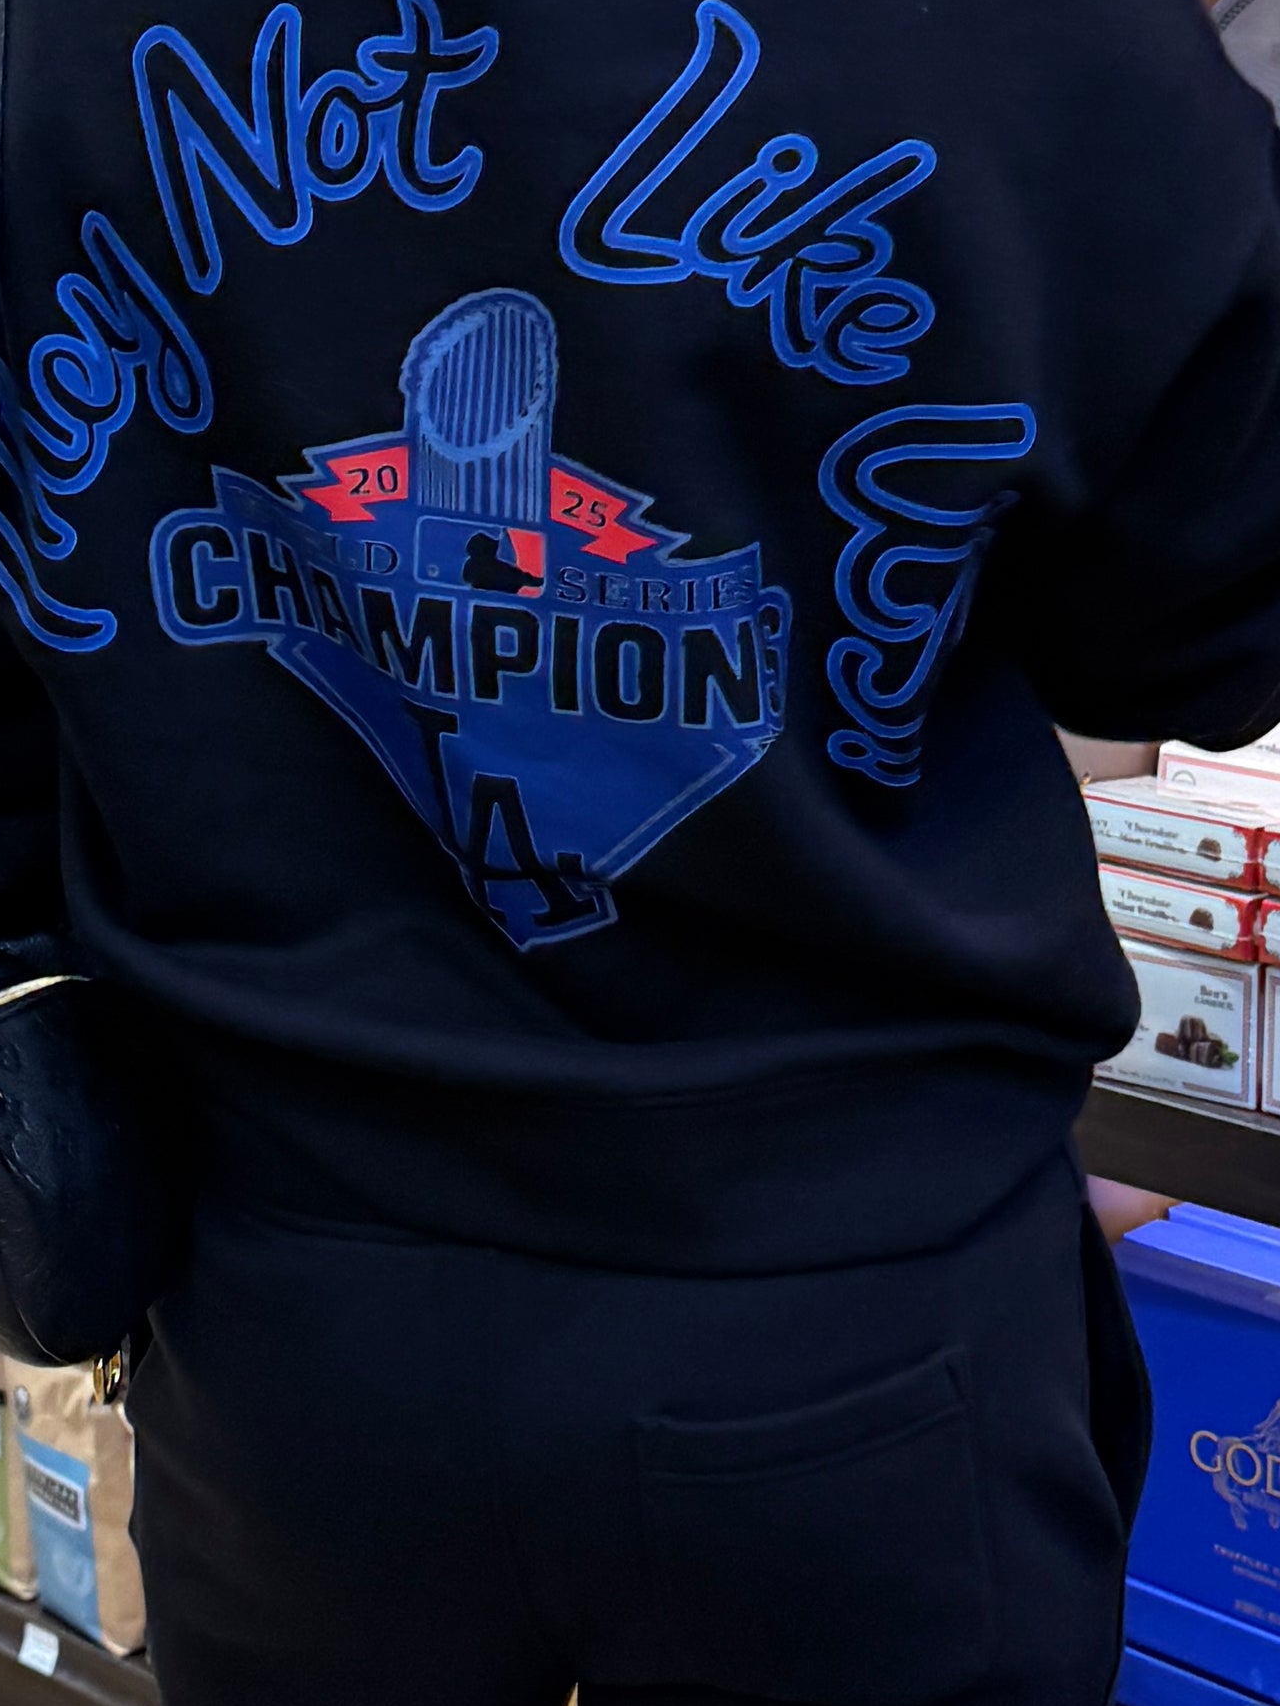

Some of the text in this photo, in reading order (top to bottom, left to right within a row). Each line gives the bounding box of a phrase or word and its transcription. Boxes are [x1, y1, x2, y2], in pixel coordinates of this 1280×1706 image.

[346, 464, 608, 529] 20 25
[1117, 887, 1171, 909] Chocolate
